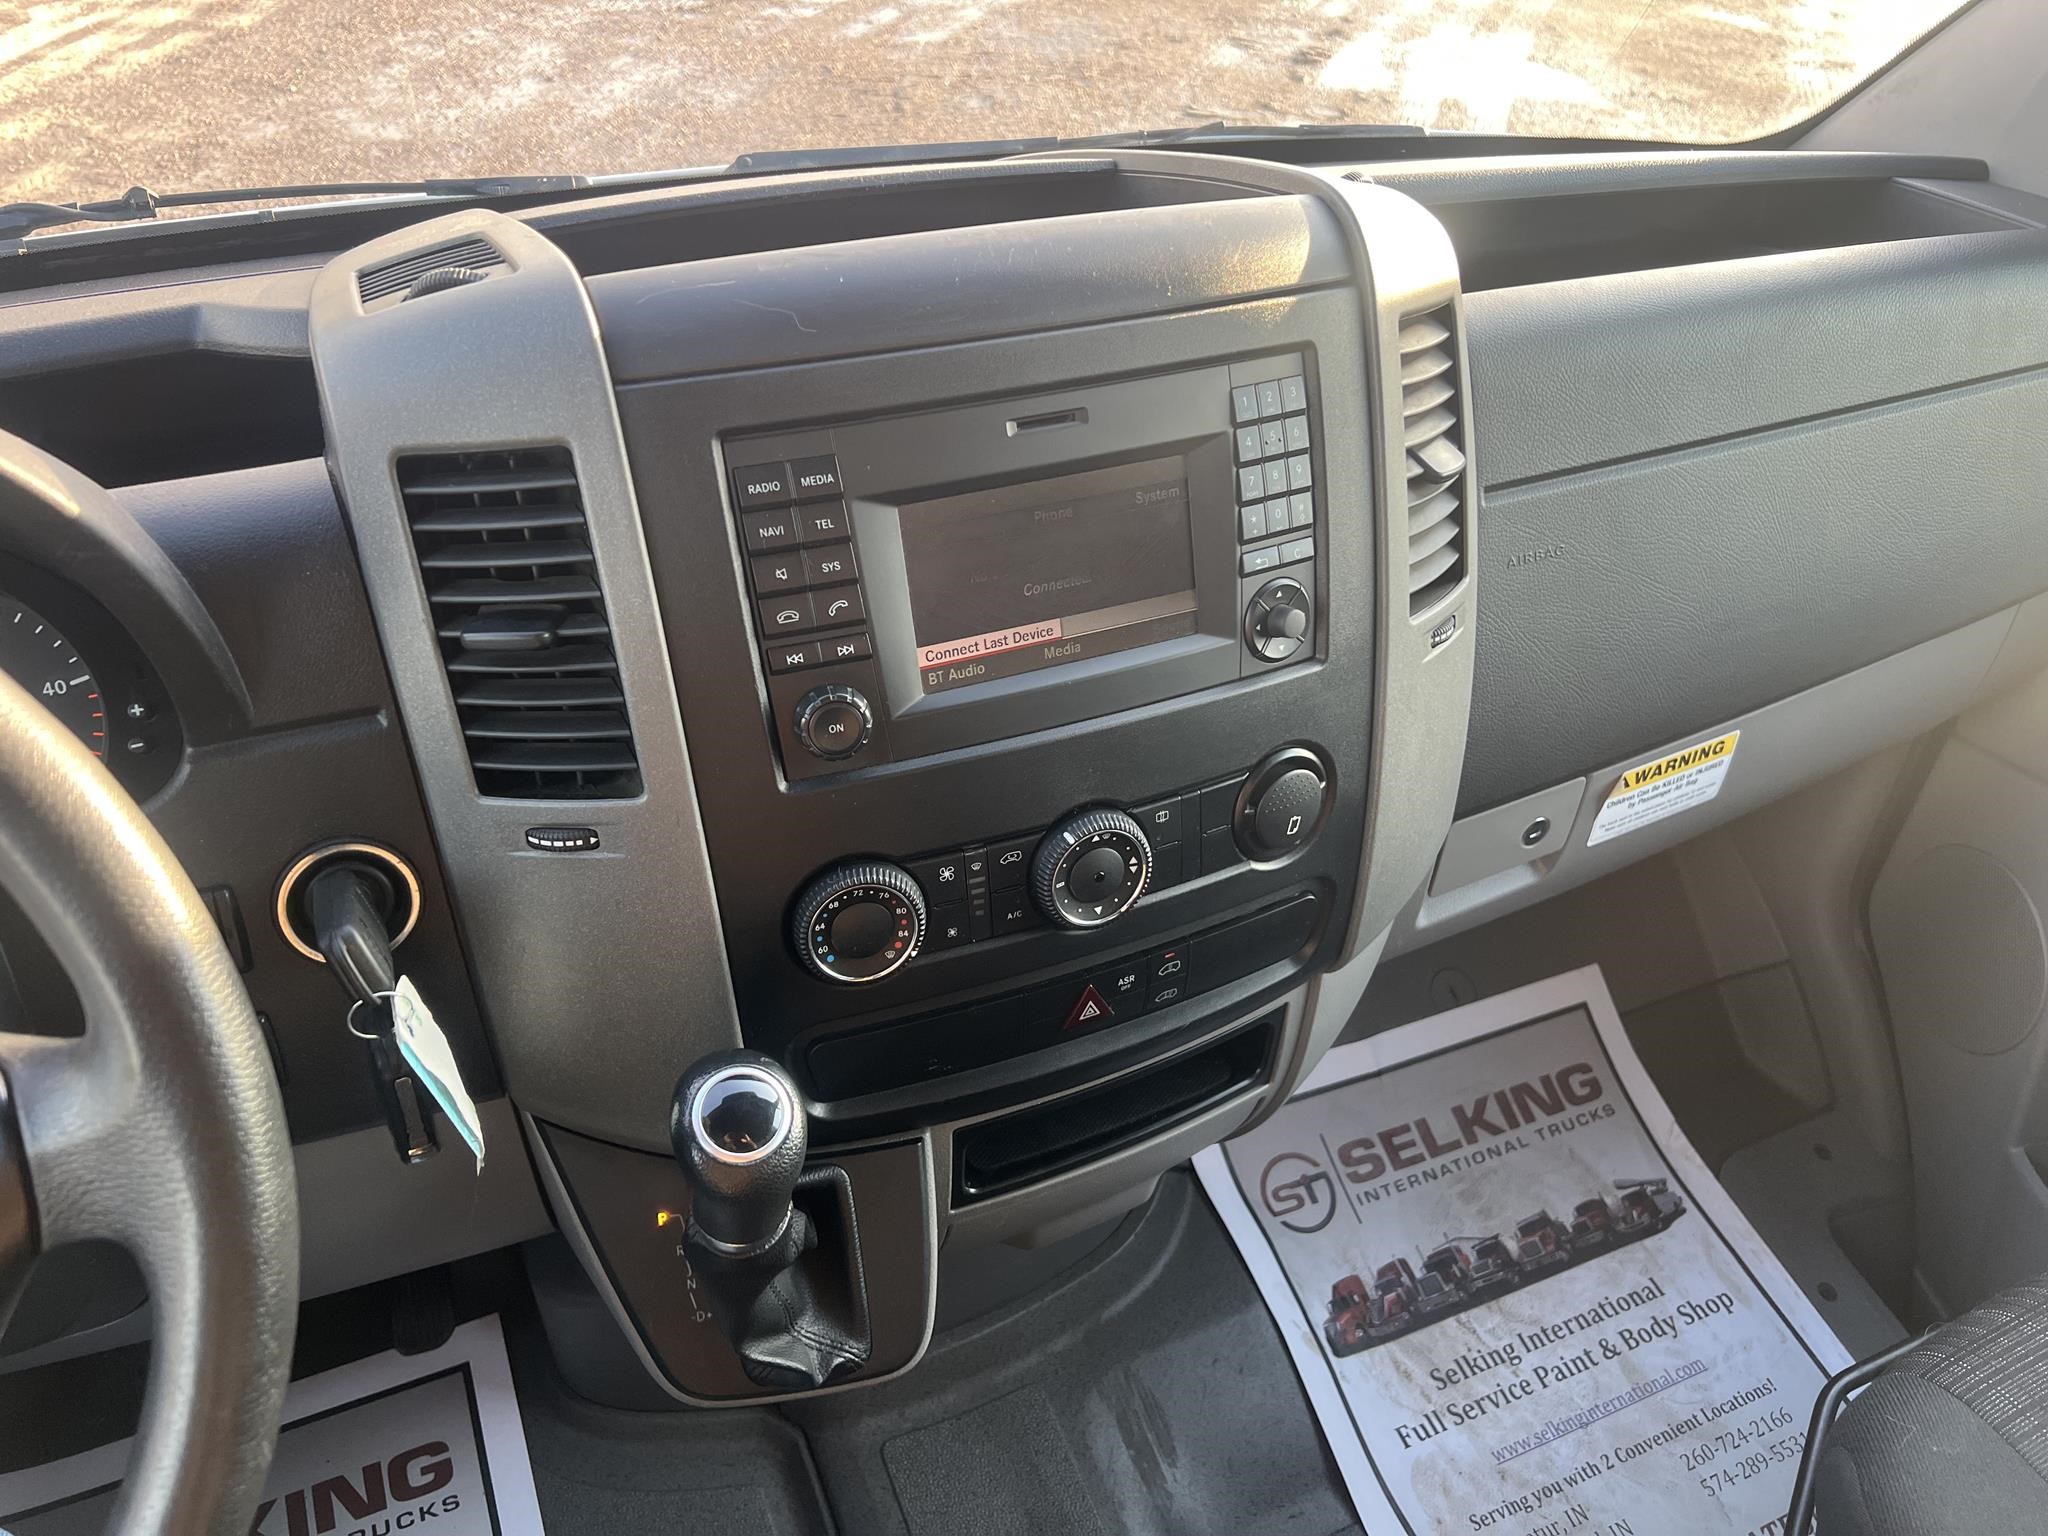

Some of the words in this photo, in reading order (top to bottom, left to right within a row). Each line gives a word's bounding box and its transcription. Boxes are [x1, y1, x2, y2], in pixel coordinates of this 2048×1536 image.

[748, 480, 781, 495] RADIO
[800, 473, 835, 488] MEDIA
[1135, 487, 1180, 506] System
[759, 525, 785, 539] NAVI
[815, 518, 835, 531] TEL
[822, 560, 841, 573] SYS
[925, 641, 980, 664] Connect
[984, 634, 1009, 650] Last
[1012, 626, 1054, 643] Device
[1043, 641, 1081, 661] Media
[928, 670, 944, 686] BT
[949, 663, 985, 682] Audio
[42, 680, 67, 697] 40
[828, 723, 845, 734] ON
[1634, 740, 1726, 785] WARNING
[852, 889, 864, 898] 72
[878, 890, 890, 900] 76
[828, 900, 840, 910] 68
[895, 906, 907, 915] 80
[1006, 909, 1023, 921] A/C
[815, 922, 826, 932] 64
[897, 929, 909, 938] 84
[817, 944, 829, 955] 60
[1118, 974, 1136, 987] ASR
[1336, 1062, 1604, 1186] SELKING
[1356, 1134, 1530, 1207] INTERNATIONAL
[1533, 1102, 1617, 1142] TRUCKS
[657, 1211, 669, 1227] P
[676, 1244, 685, 1257] R
[686, 1278, 697, 1290] N
[1430, 1341, 1523, 1391] Selking
[1515, 1277, 1667, 1354] International
[1394, 1409, 1448, 1450] Full
[1446, 1377, 1534, 1427] Service
[1532, 1349, 1600, 1390] Paint
[1598, 1336, 1622, 1361] &
[1617, 1314, 1679, 1352] Body
[1676, 1290, 1736, 1325] Shop
[1490, 1356, 1708, 1465] www.selkinginternational.com
[1679, 1405, 1793, 1472] 260-724-2166
[1468, 1494, 1535, 1532] Serving
[1531, 1479, 1564, 1509] you
[1563, 1459, 1602, 1489] with
[1600, 1453, 1615, 1472] 2
[1613, 1414, 1705, 1463] Convenient
[1700, 1377, 1778, 1423] Locations!
[1564, 1503, 1590, 1528] IN
[1608, 1518, 1635, 1536] IN
